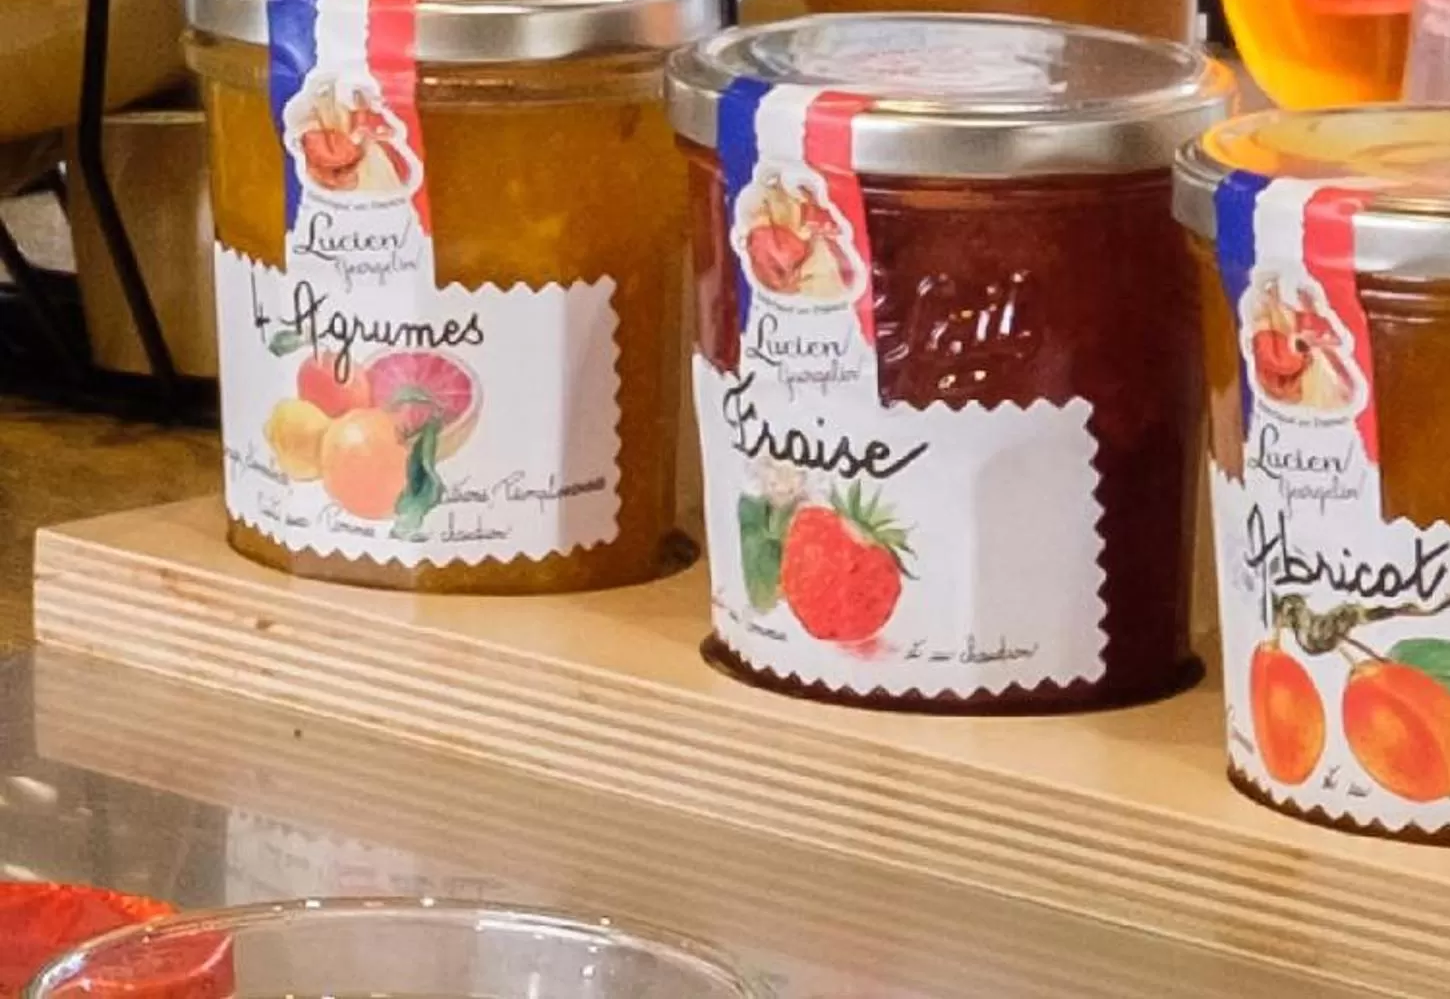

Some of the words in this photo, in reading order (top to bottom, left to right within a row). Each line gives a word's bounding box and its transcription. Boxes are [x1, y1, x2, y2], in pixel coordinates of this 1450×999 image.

[292, 211, 411, 261] Lucien
[280, 280, 484, 384] Agrumes
[745, 313, 850, 367] Lucien
[722, 372, 929, 479] Fraise
[1247, 422, 1354, 479] Lucien
[1243, 503, 1450, 629] Abricot
